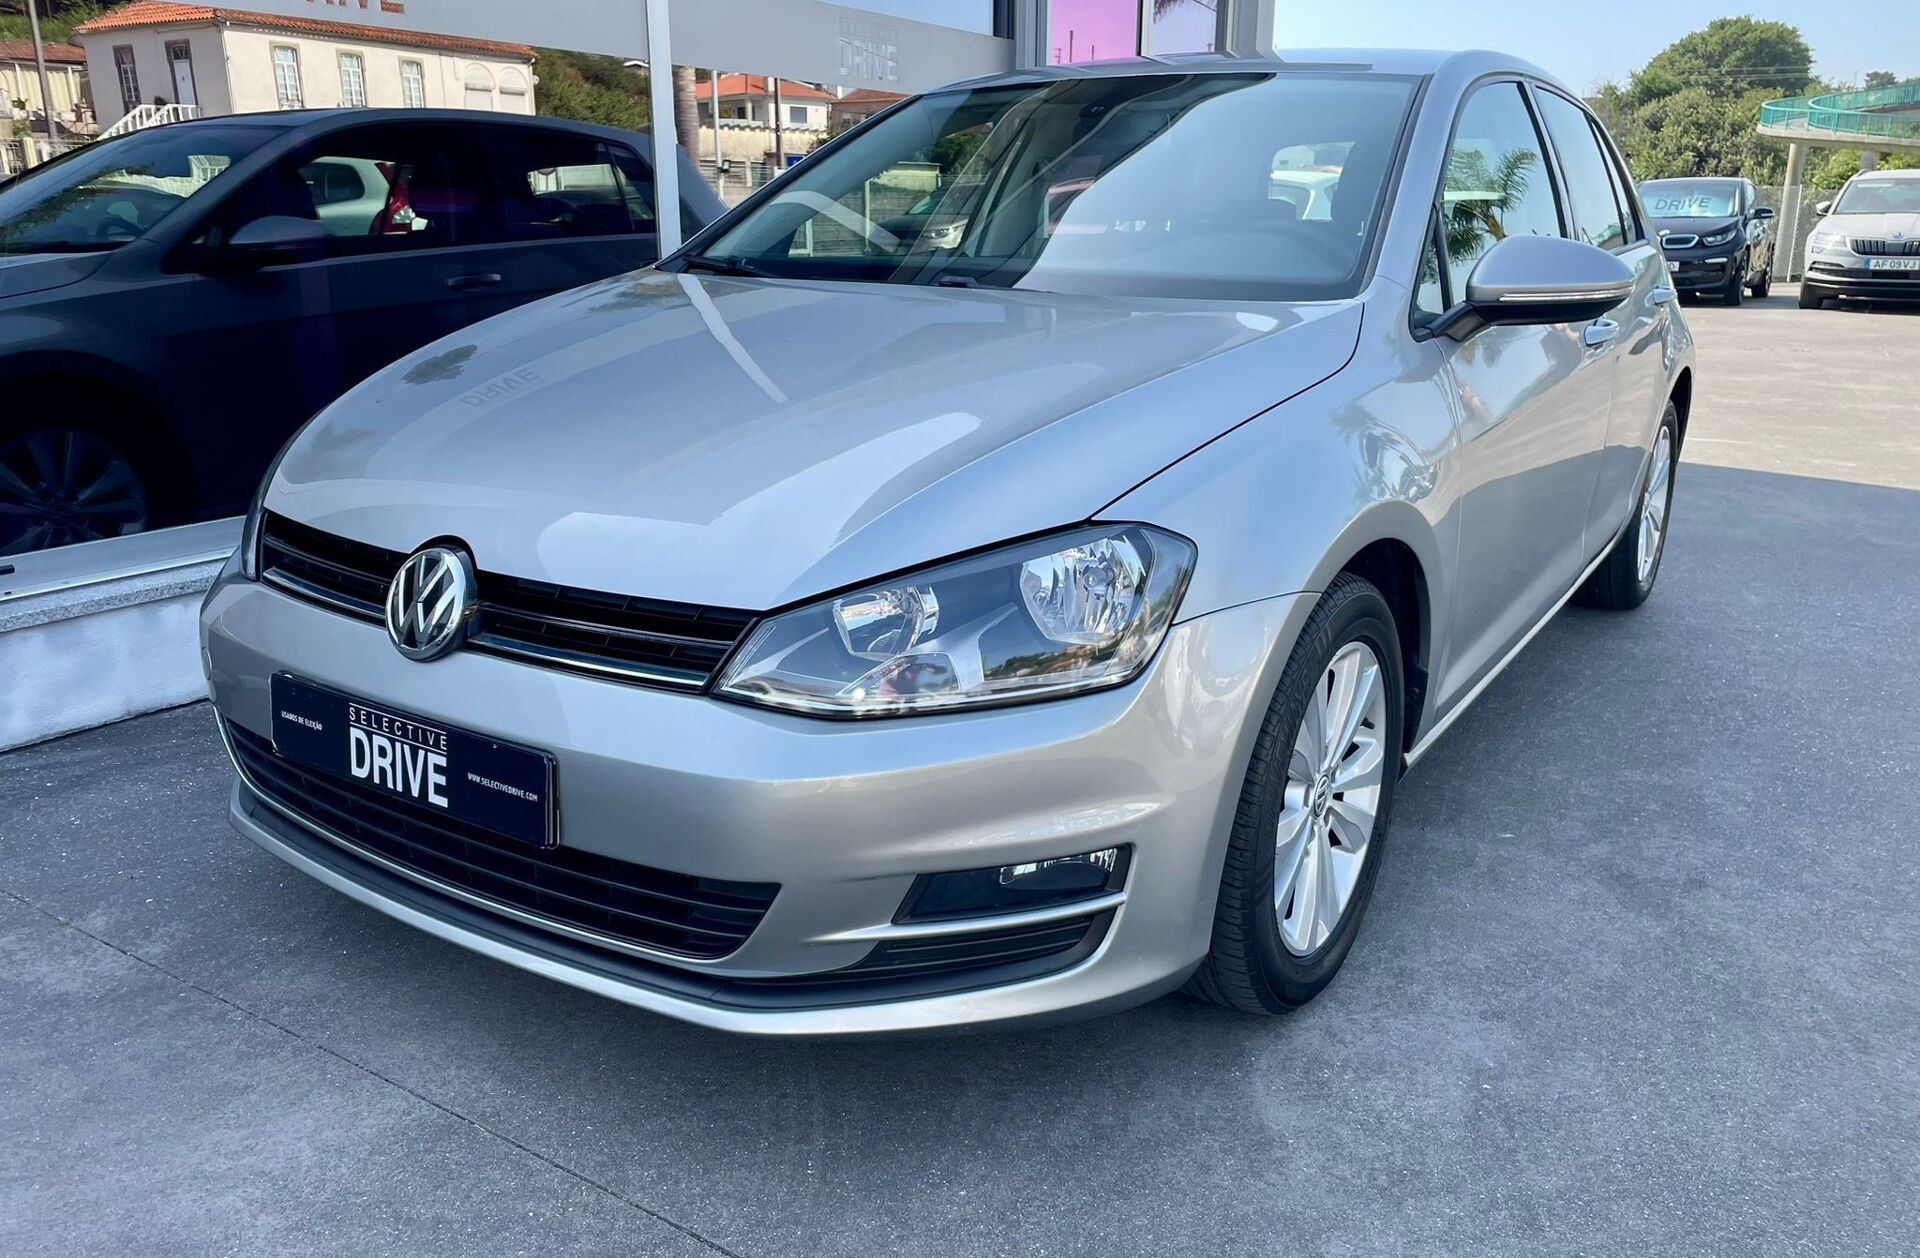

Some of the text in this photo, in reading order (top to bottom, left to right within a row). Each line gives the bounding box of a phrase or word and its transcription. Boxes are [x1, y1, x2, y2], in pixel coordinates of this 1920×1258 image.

[839, 37, 899, 81] DRIVE
[1655, 197, 1712, 211] DRIVE
[1873, 260, 1916, 269] AF 09 VJ
[349, 706, 448, 750] SELECTIVE
[350, 727, 448, 808] DRIVE
